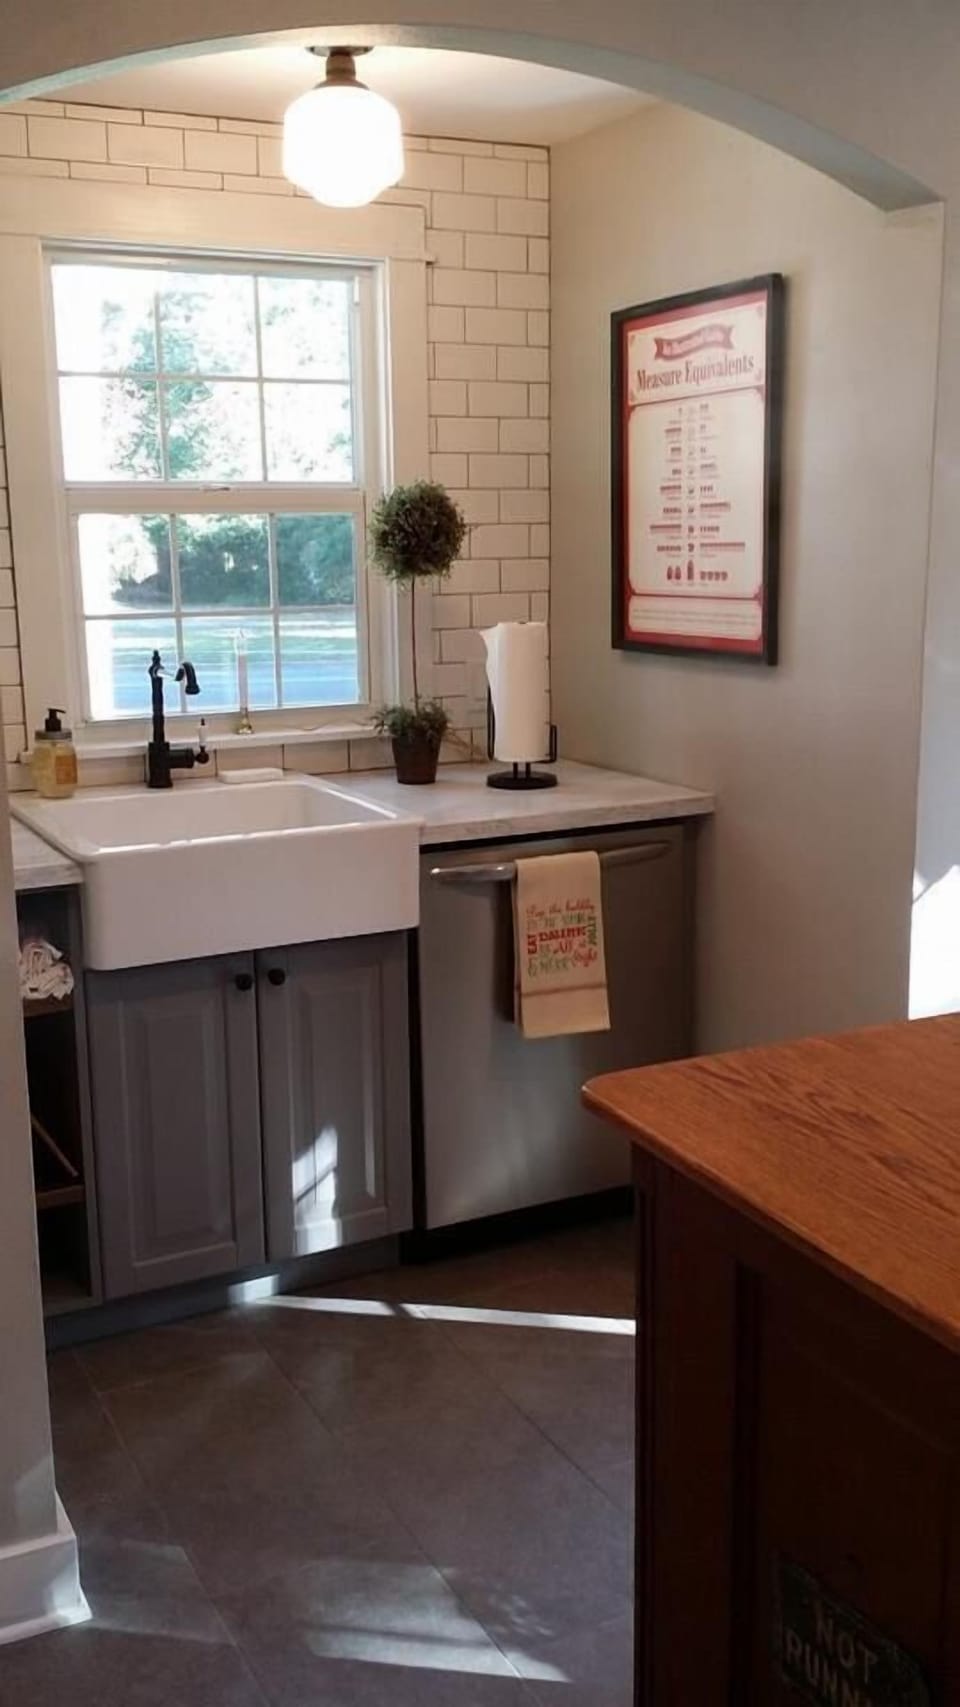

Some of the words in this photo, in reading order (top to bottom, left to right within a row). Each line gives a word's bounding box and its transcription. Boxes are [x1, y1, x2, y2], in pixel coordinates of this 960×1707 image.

[636, 368, 682, 391] Measure
[685, 355, 755, 386] Equivalents
[785, 1625, 874, 1707] RUNN
[812, 1599, 880, 1686] NOT
